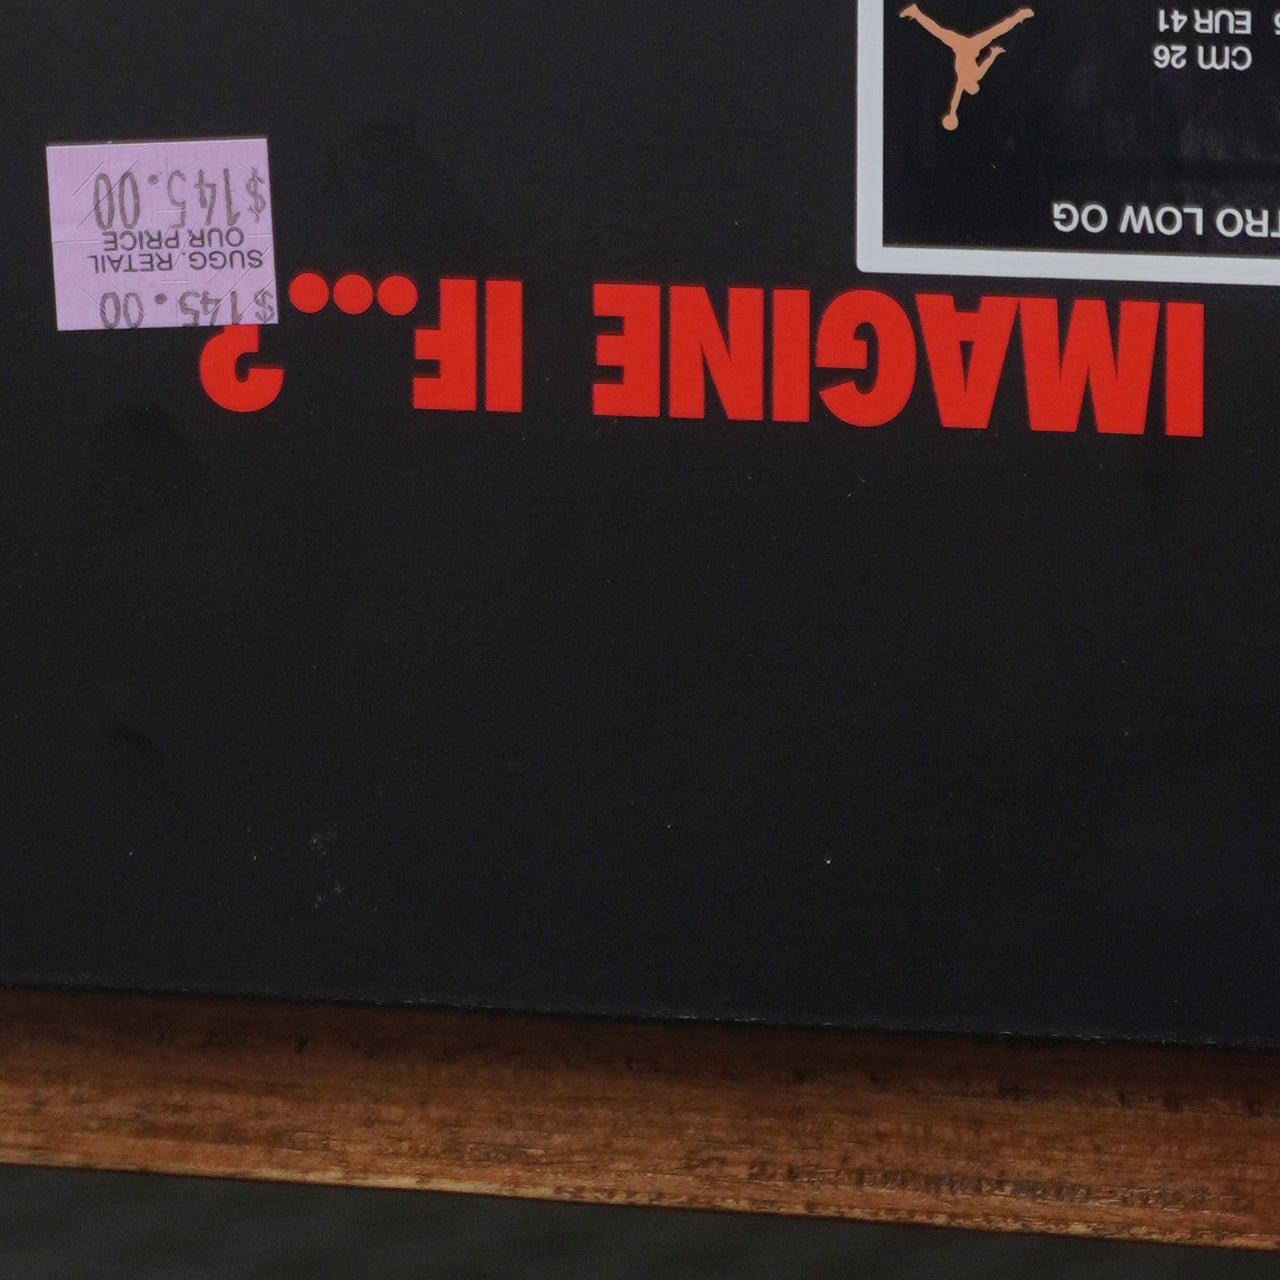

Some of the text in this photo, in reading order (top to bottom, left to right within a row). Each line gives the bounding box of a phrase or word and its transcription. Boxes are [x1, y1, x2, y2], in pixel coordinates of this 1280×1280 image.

[1159, 10, 1187, 32] 41
[1194, 9, 1251, 34] EUR
[1154, 45, 1186, 69] 26
[1198, 46, 1252, 70] cm
[93, 167, 266, 231] $145.00
[1053, 203, 1108, 233] OG
[1120, 206, 1203, 235] LOW
[101, 227, 245, 251] OUR PRICE
[86, 249, 263, 274] SUGG. RETAIL
[100, 290, 275, 329] $145.00
[592, 282, 1204, 437] IMAGINE
